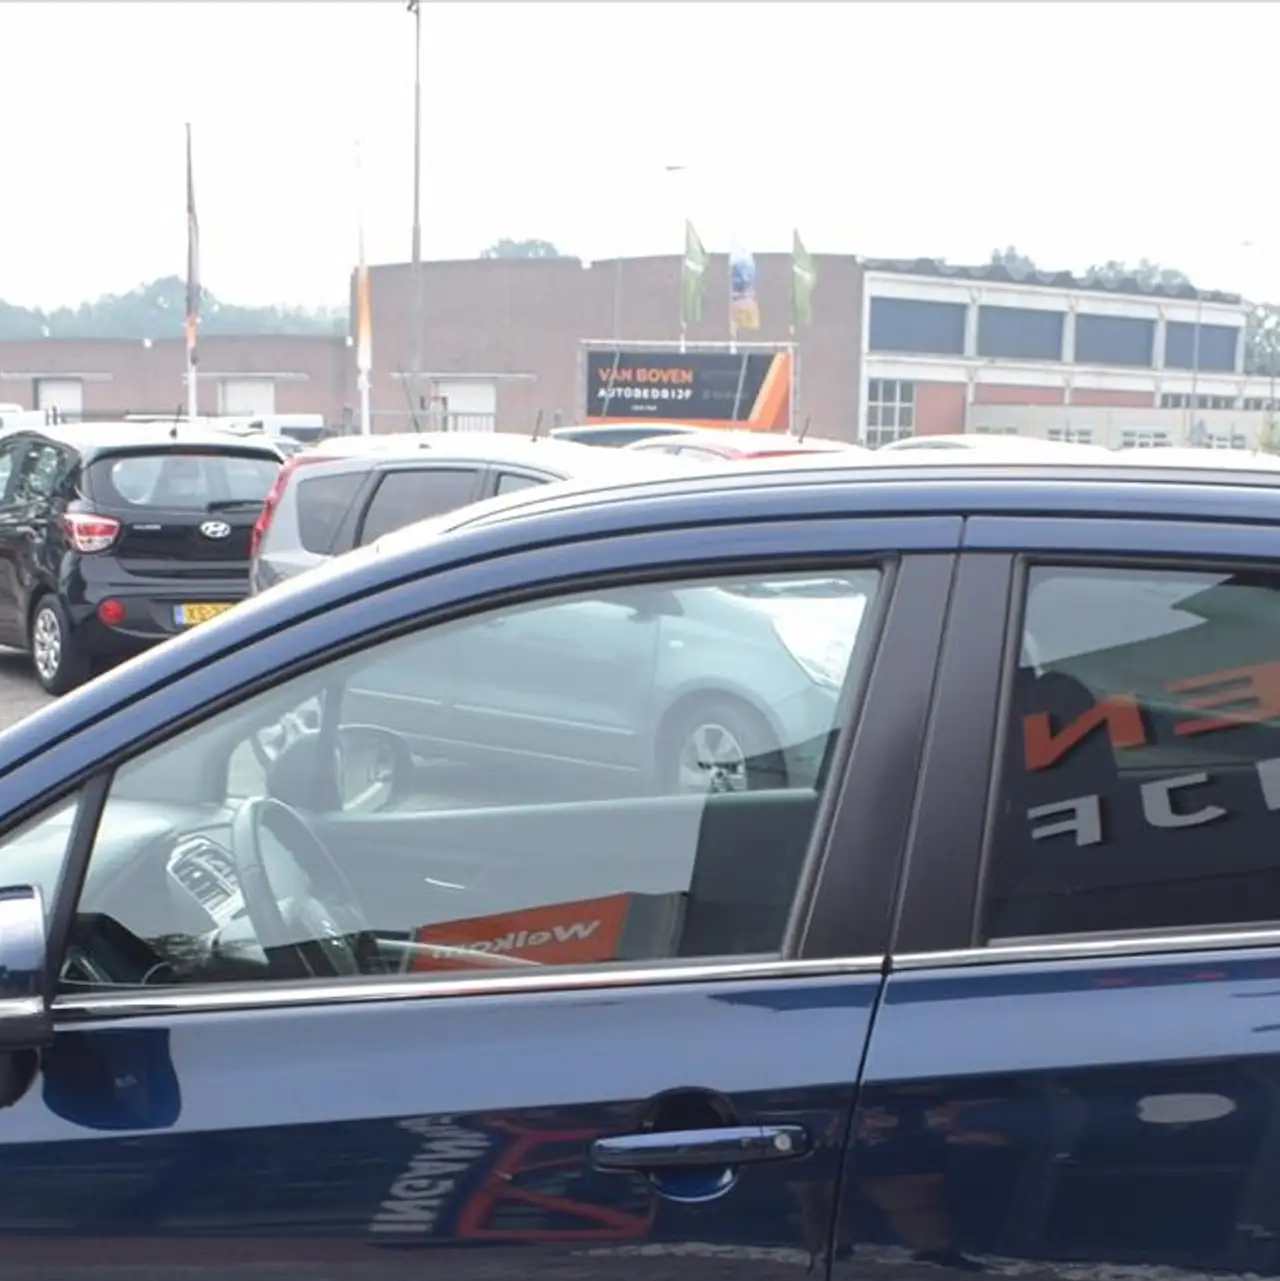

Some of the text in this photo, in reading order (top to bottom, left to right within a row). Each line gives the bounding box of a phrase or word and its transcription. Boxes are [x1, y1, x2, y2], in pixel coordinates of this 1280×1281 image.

[598, 368, 633, 382] VAN
[636, 368, 694, 383] BOVEN
[597, 387, 694, 400] AUTOBEDRIJF
